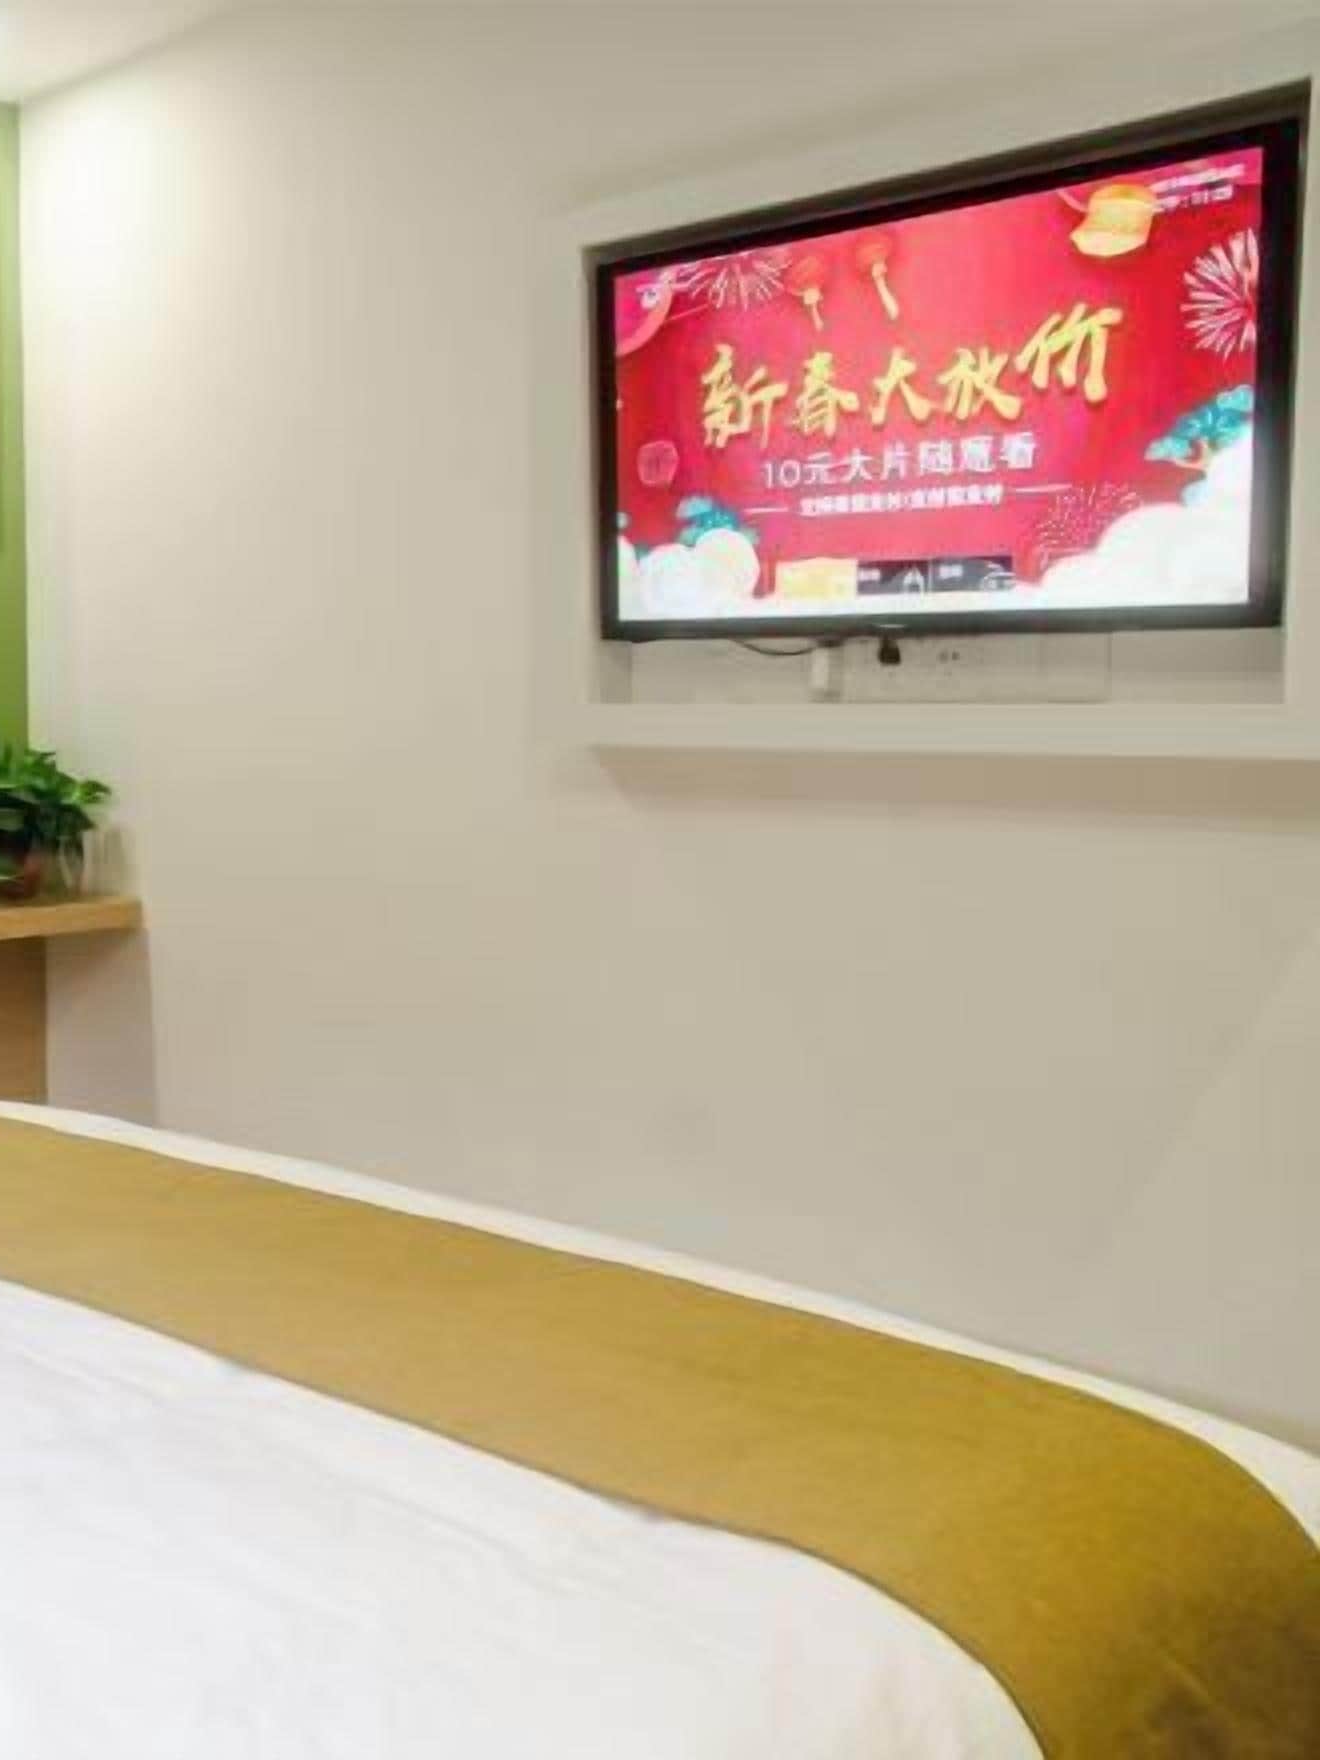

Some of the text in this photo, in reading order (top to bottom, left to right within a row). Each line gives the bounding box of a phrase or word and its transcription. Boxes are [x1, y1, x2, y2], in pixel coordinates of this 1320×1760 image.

[701, 303, 1123, 449] 新春大放价
